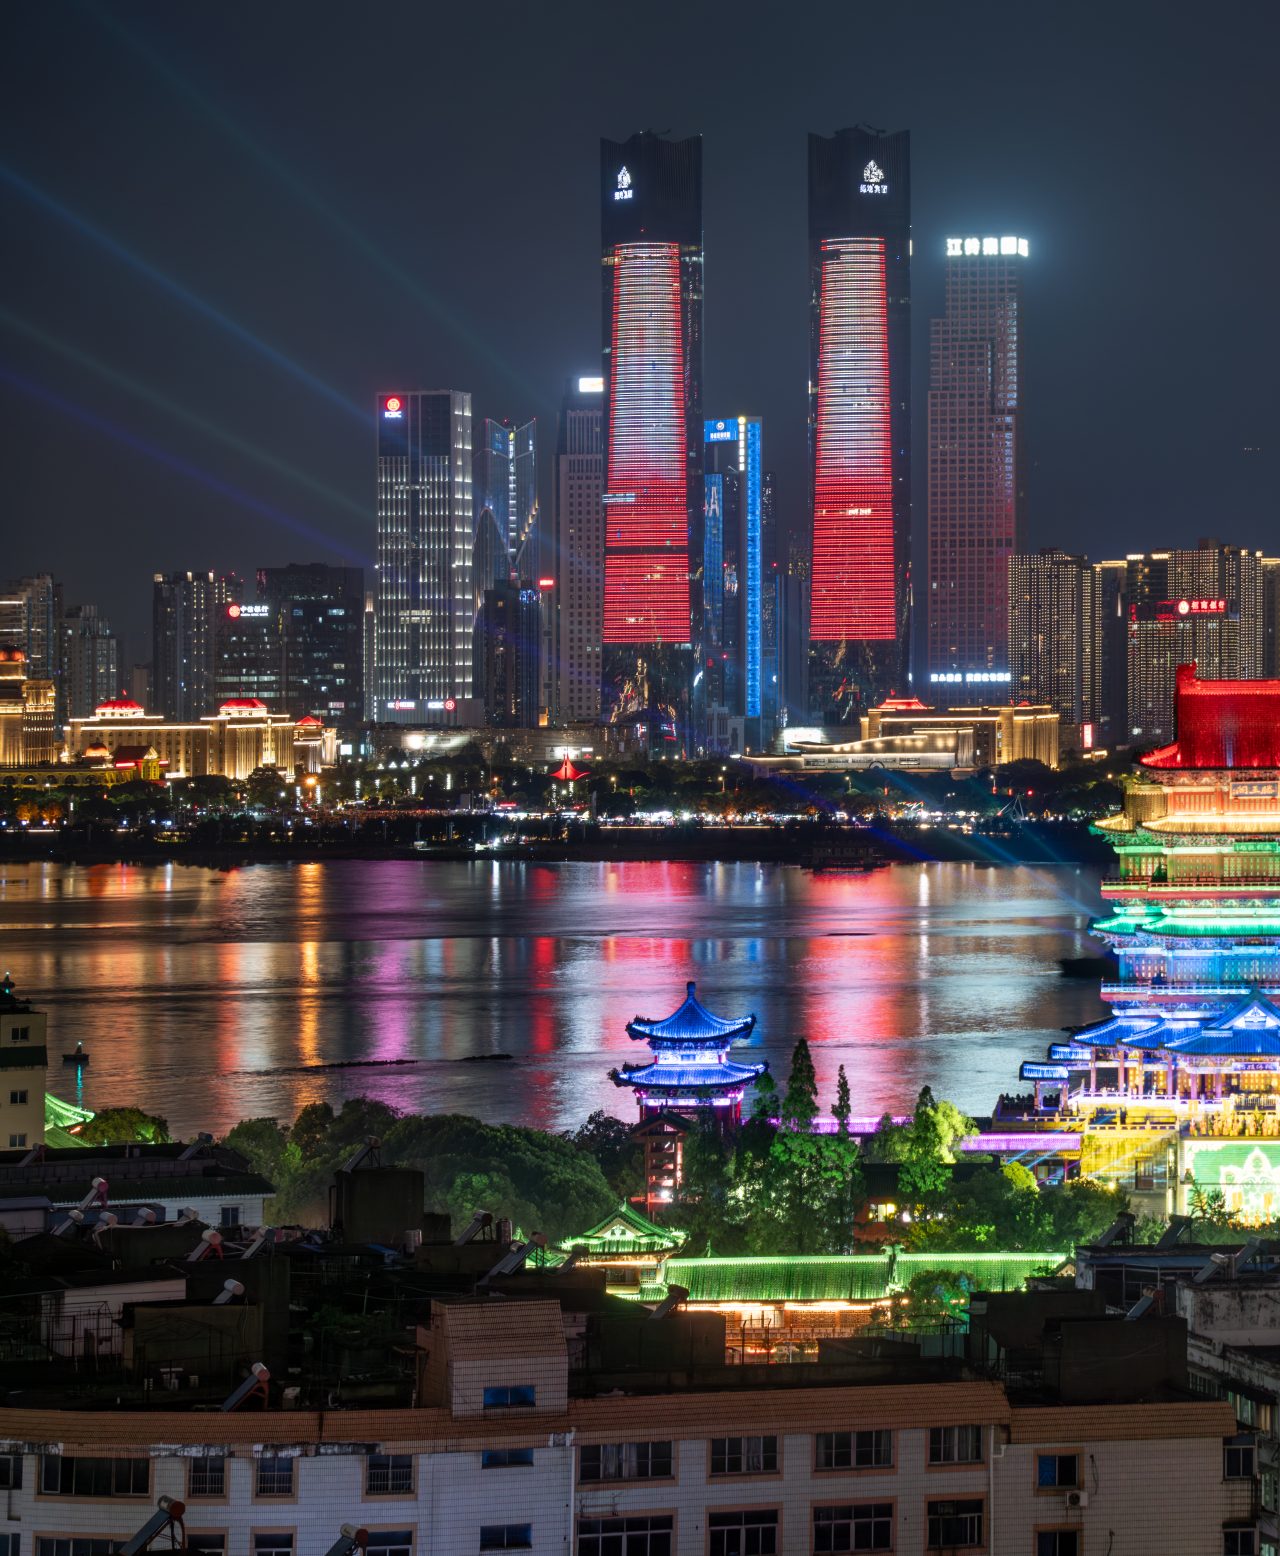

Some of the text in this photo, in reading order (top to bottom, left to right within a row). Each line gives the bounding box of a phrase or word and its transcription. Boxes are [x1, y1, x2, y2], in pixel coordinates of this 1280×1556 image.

[240, 605, 269, 613] 中信银行
[1191, 600, 1225, 610] 招商银行
